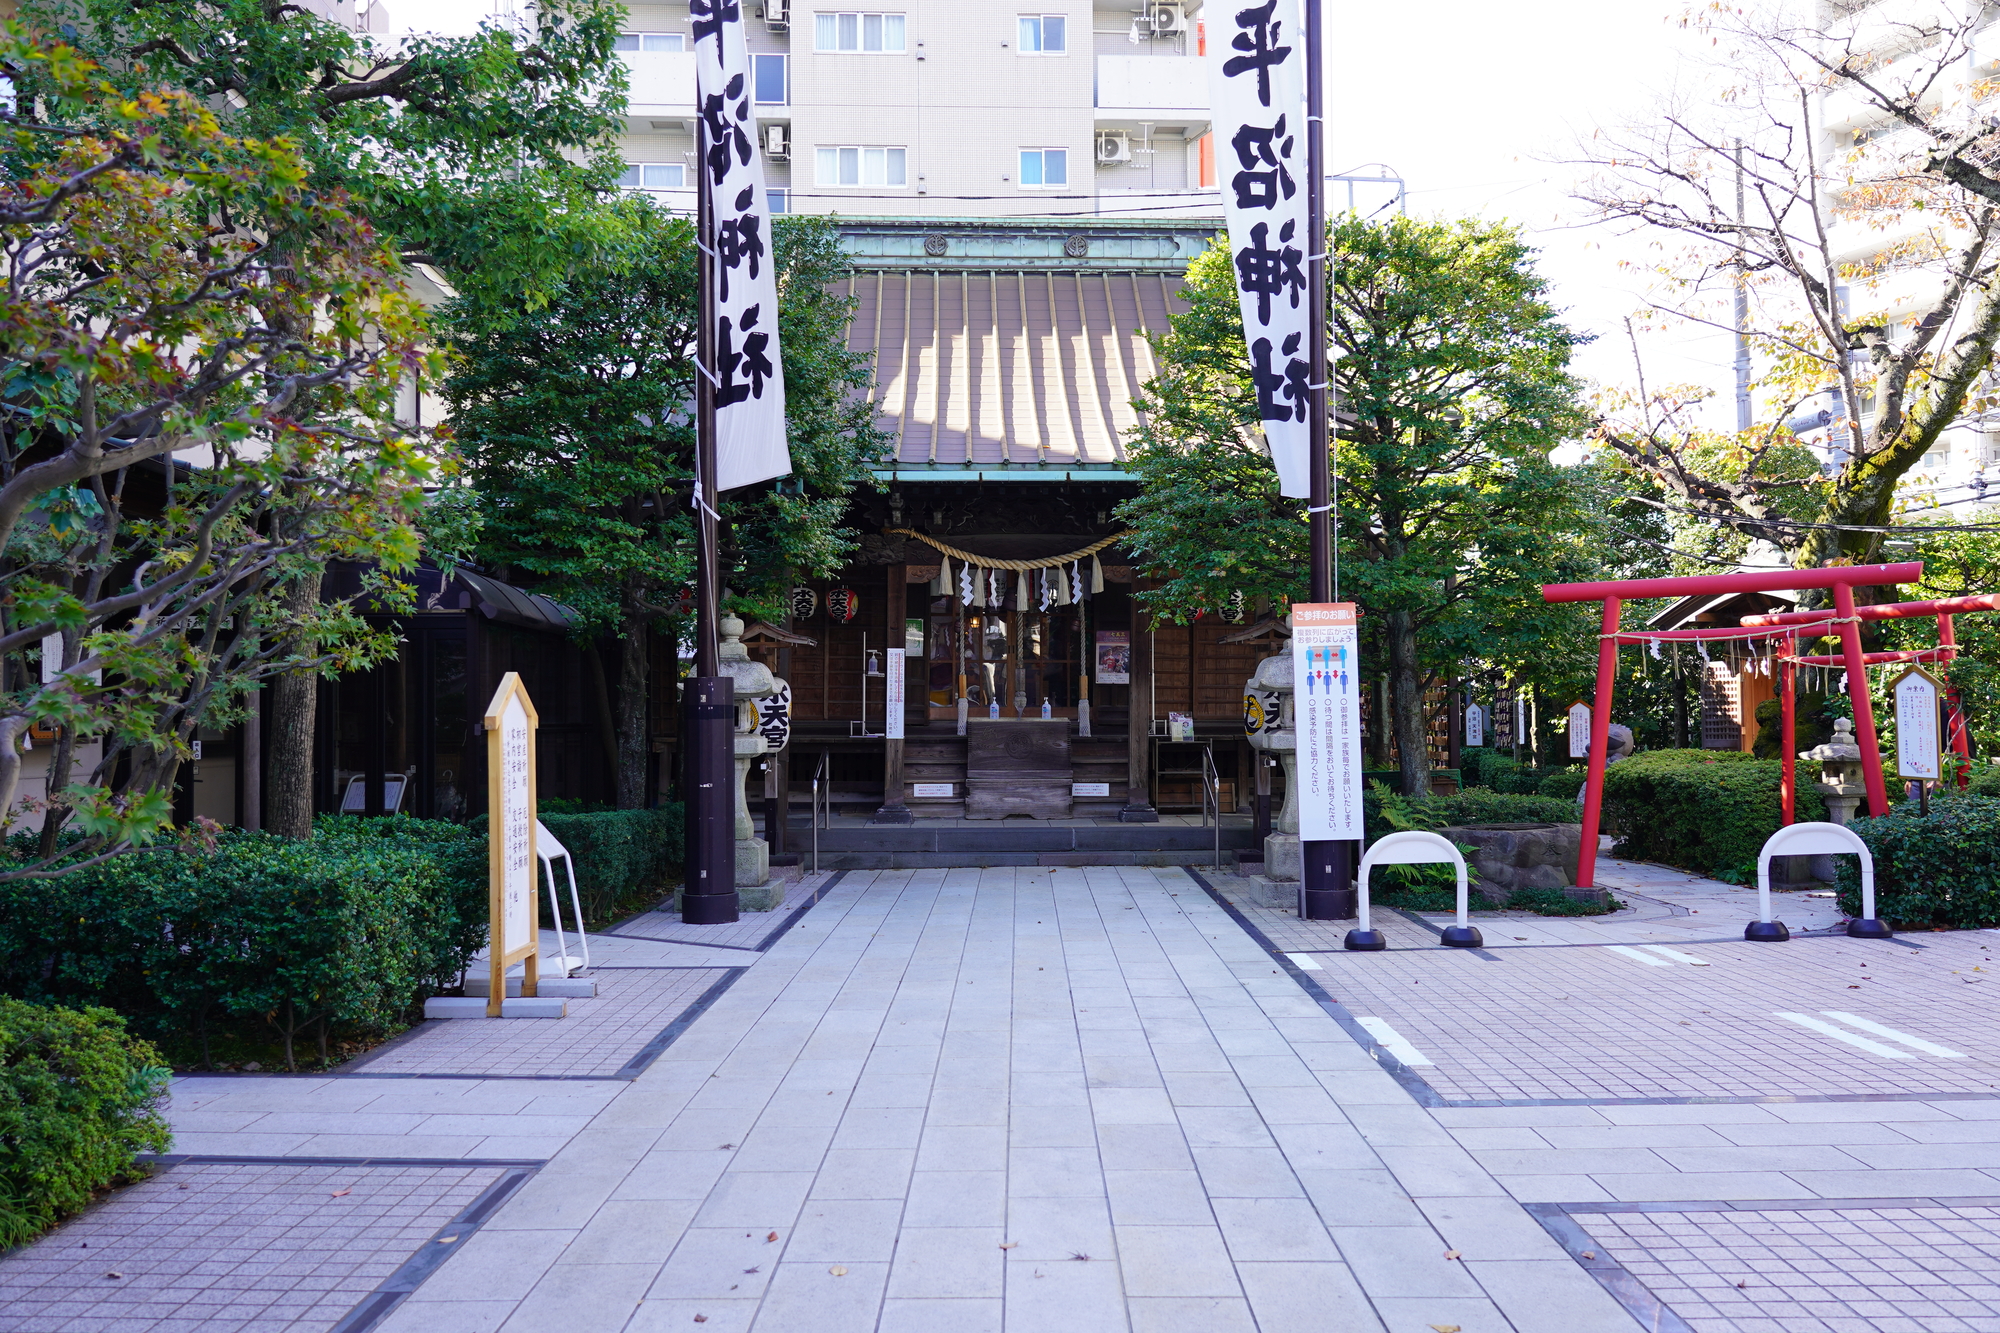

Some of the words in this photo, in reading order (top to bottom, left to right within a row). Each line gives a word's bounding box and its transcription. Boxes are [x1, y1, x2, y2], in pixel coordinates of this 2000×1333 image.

[793, 589, 815, 618] 水天宮
[829, 589, 850, 620] 水天宮
[1295, 609, 1355, 621] ご参拝のお願い
[1297, 628, 1354, 637] 複数列に広がって
[1297, 636, 1352, 644] お参りしましょう
[759, 684, 790, 749] 水天宮
